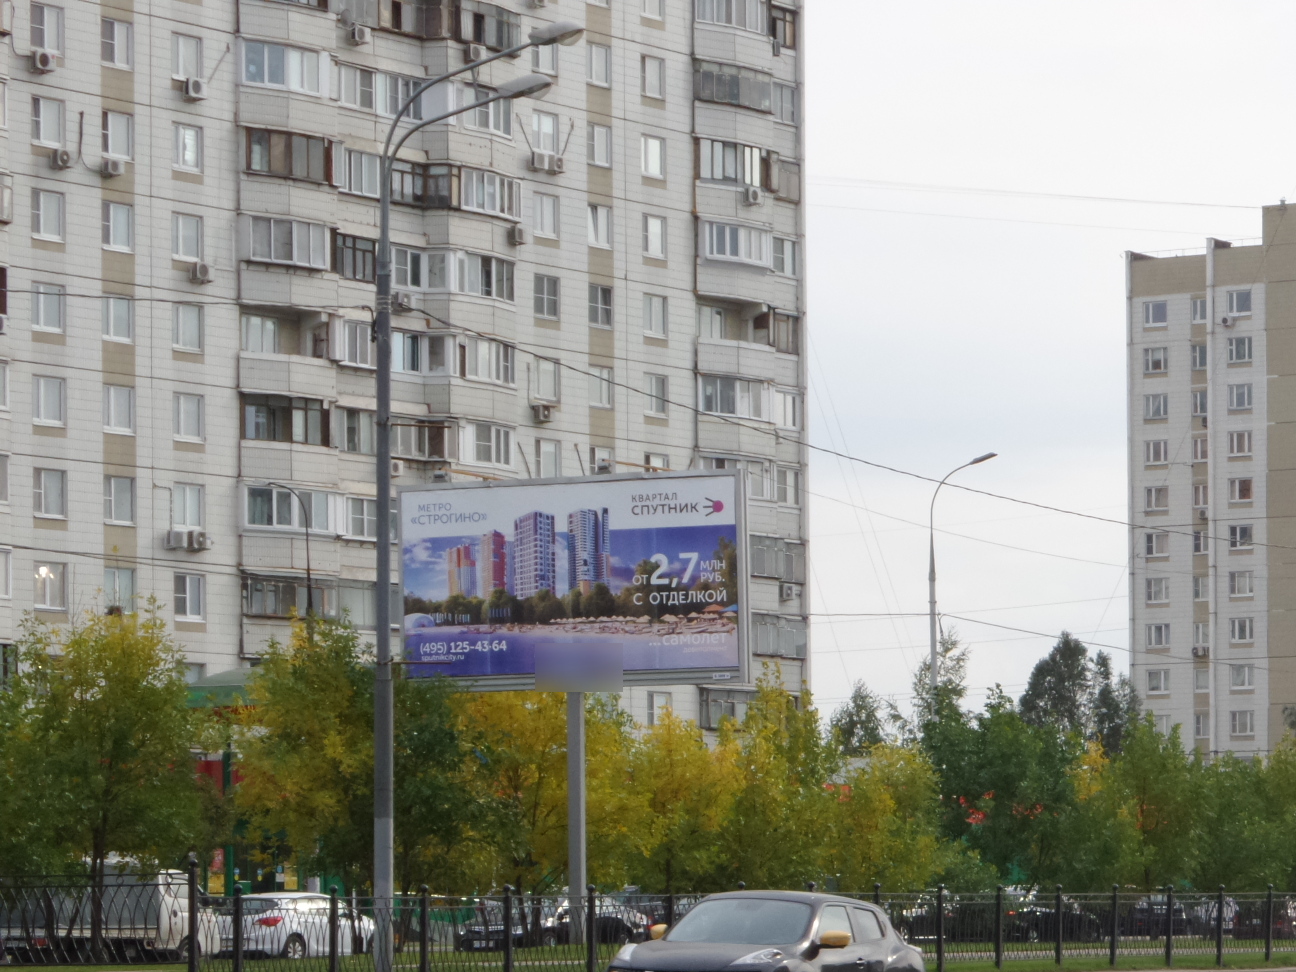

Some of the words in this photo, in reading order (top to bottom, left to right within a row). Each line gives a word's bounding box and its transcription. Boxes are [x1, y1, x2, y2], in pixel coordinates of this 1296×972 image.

[631, 492, 678, 503] КВАРТАЛ
[418, 502, 452, 513] МЕТРО
[631, 502, 699, 516] СПУТНИК
[410, 512, 487, 525] «СТРОГИНО»
[632, 574, 649, 586] ОТ
[650, 552, 699, 588] 2,7
[700, 560, 725, 571] МЛН
[700, 571, 725, 583] РУБ.
[633, 592, 643, 606] С
[649, 587, 727, 606] ОТДЕЛКОЙ
[420, 641, 447, 655] (495)
[450, 640, 507, 653] 125-43-64
[421, 653, 465, 662] sputnikcity.ru
